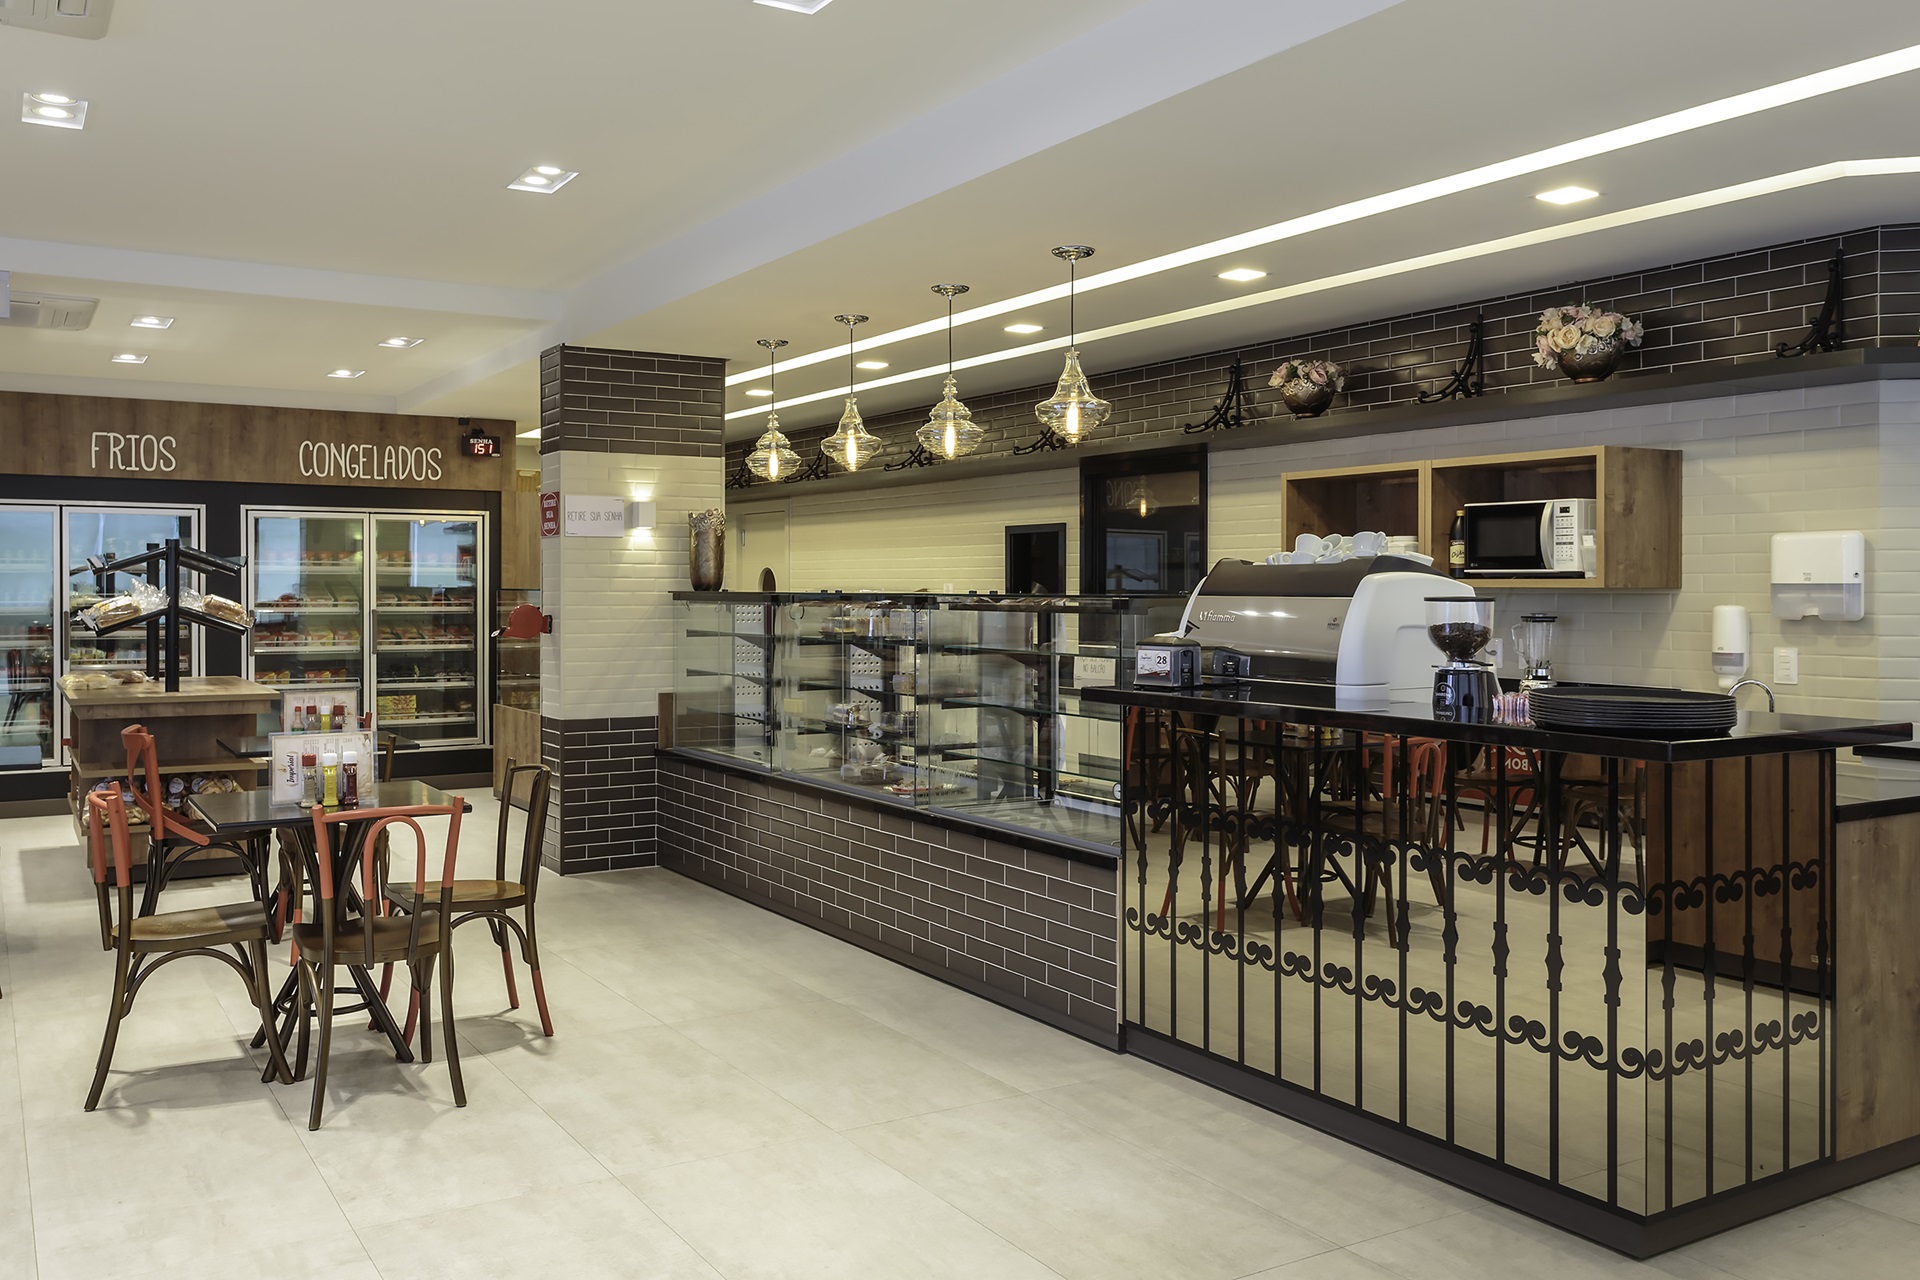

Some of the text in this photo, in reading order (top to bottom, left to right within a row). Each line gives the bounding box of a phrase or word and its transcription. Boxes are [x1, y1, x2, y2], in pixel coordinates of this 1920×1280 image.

[91, 431, 176, 472] FRIOS
[474, 443, 493, 455] 151
[299, 440, 442, 481] CONGELADOS
[567, 510, 622, 521] RETIRE SUA SENHA
[1156, 655, 1168, 665] 28
[286, 754, 297, 784] Imperial
